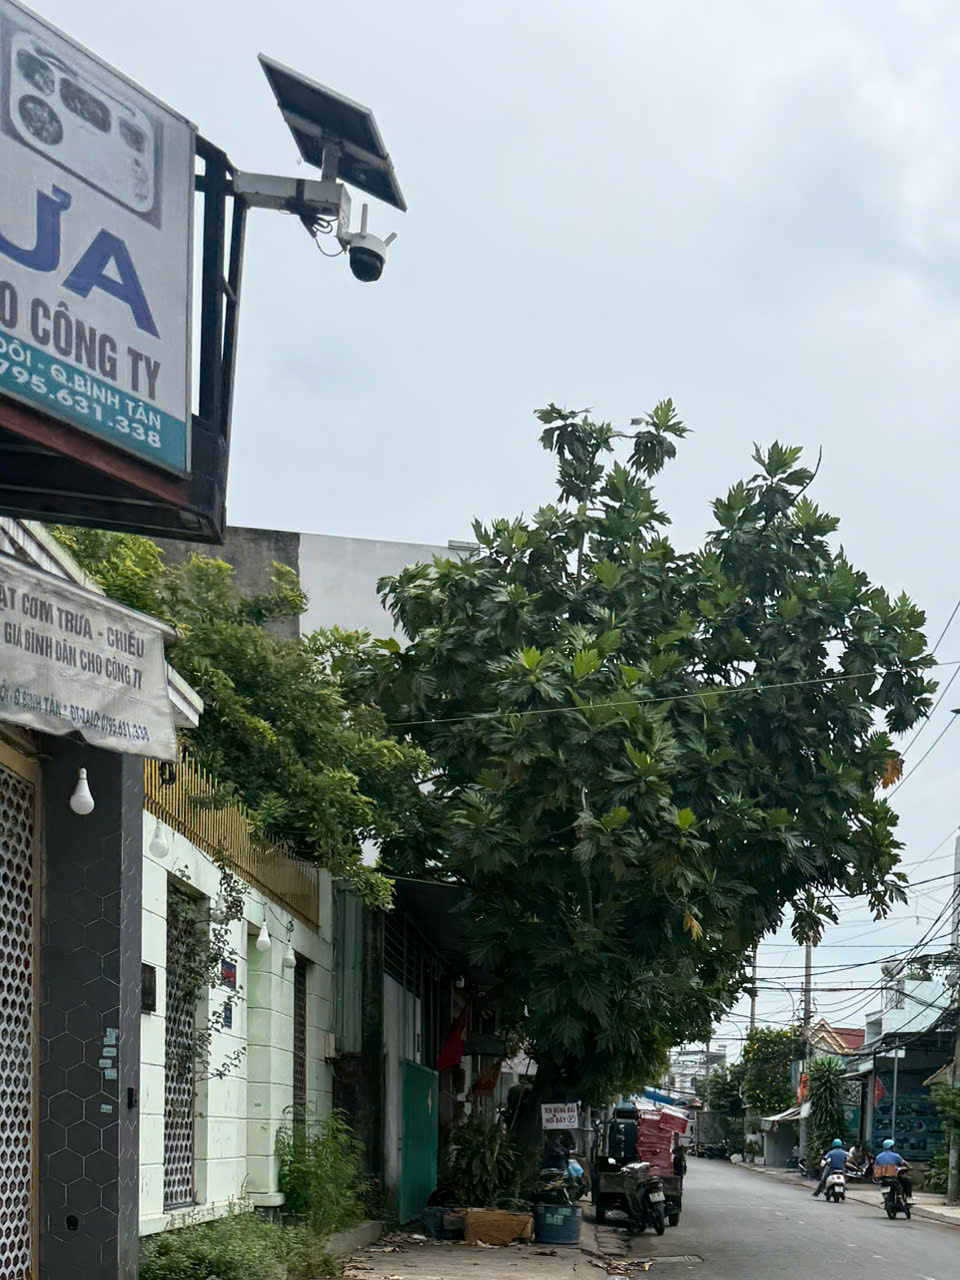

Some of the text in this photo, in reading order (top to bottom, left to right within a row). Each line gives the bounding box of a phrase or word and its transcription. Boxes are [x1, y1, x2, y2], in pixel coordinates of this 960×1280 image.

[30, 298, 118, 382] CÔNG
[127, 346, 161, 401] TY
[50, 363, 120, 410] Q.BÌNH
[125, 399, 161, 431] TÂN
[22, 592, 54, 625] CƠM
[56, 606, 94, 641] TRƯA
[24, 626, 53, 660] BÌNH
[55, 638, 78, 668] DÂN
[80, 648, 103, 676] CHO
[105, 656, 132, 686] CÔNG
